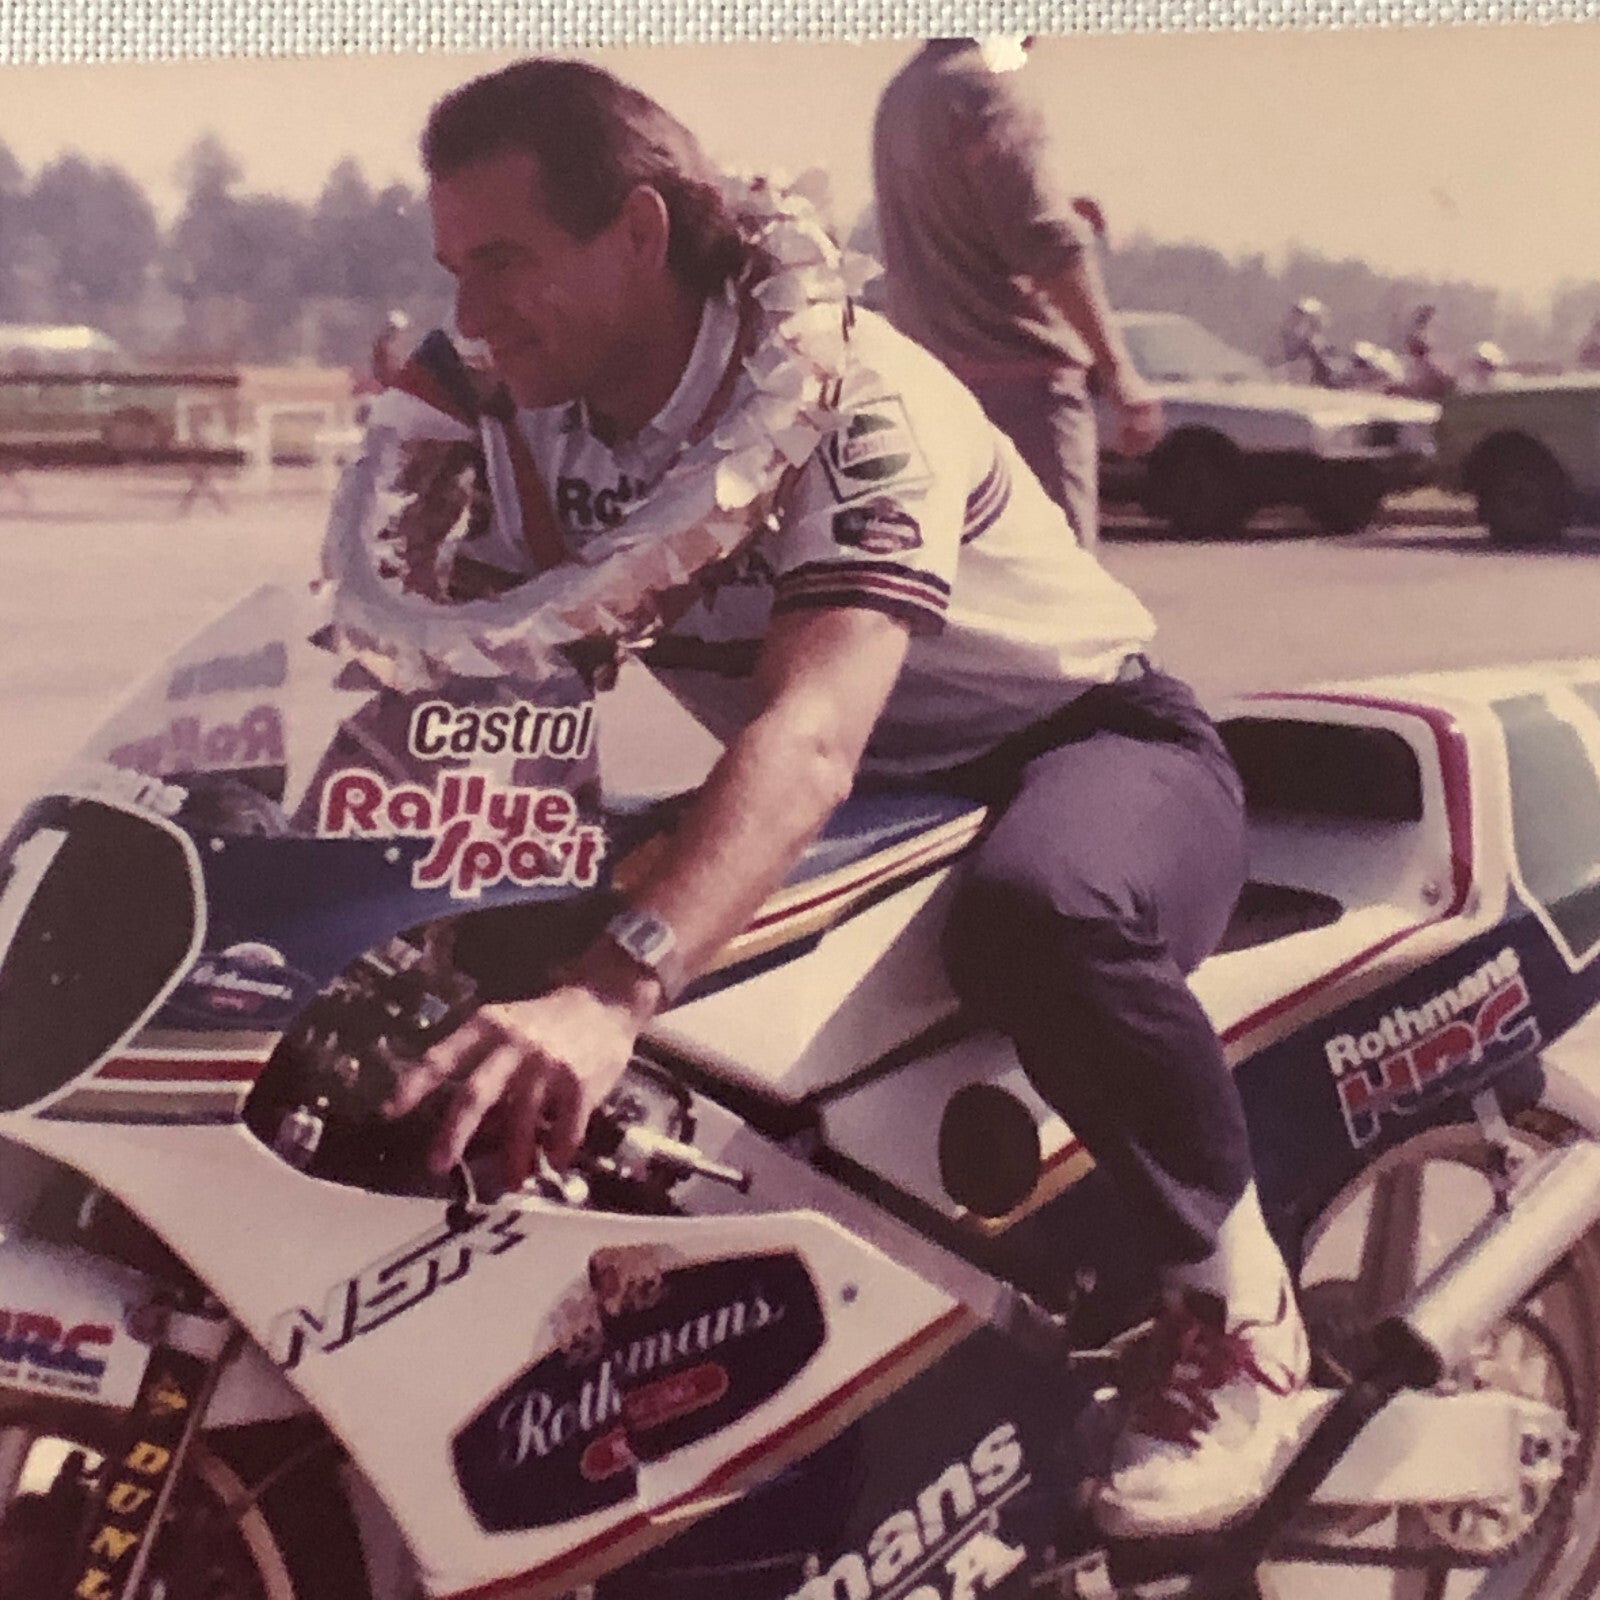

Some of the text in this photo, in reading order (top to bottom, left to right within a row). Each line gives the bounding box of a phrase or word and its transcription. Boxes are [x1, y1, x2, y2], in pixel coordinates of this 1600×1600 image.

[411, 701, 596, 758] Castrol
[319, 769, 575, 845] Rallye
[1325, 947, 1520, 1076] Rothmans
[784, 1422, 1022, 1600] mans
